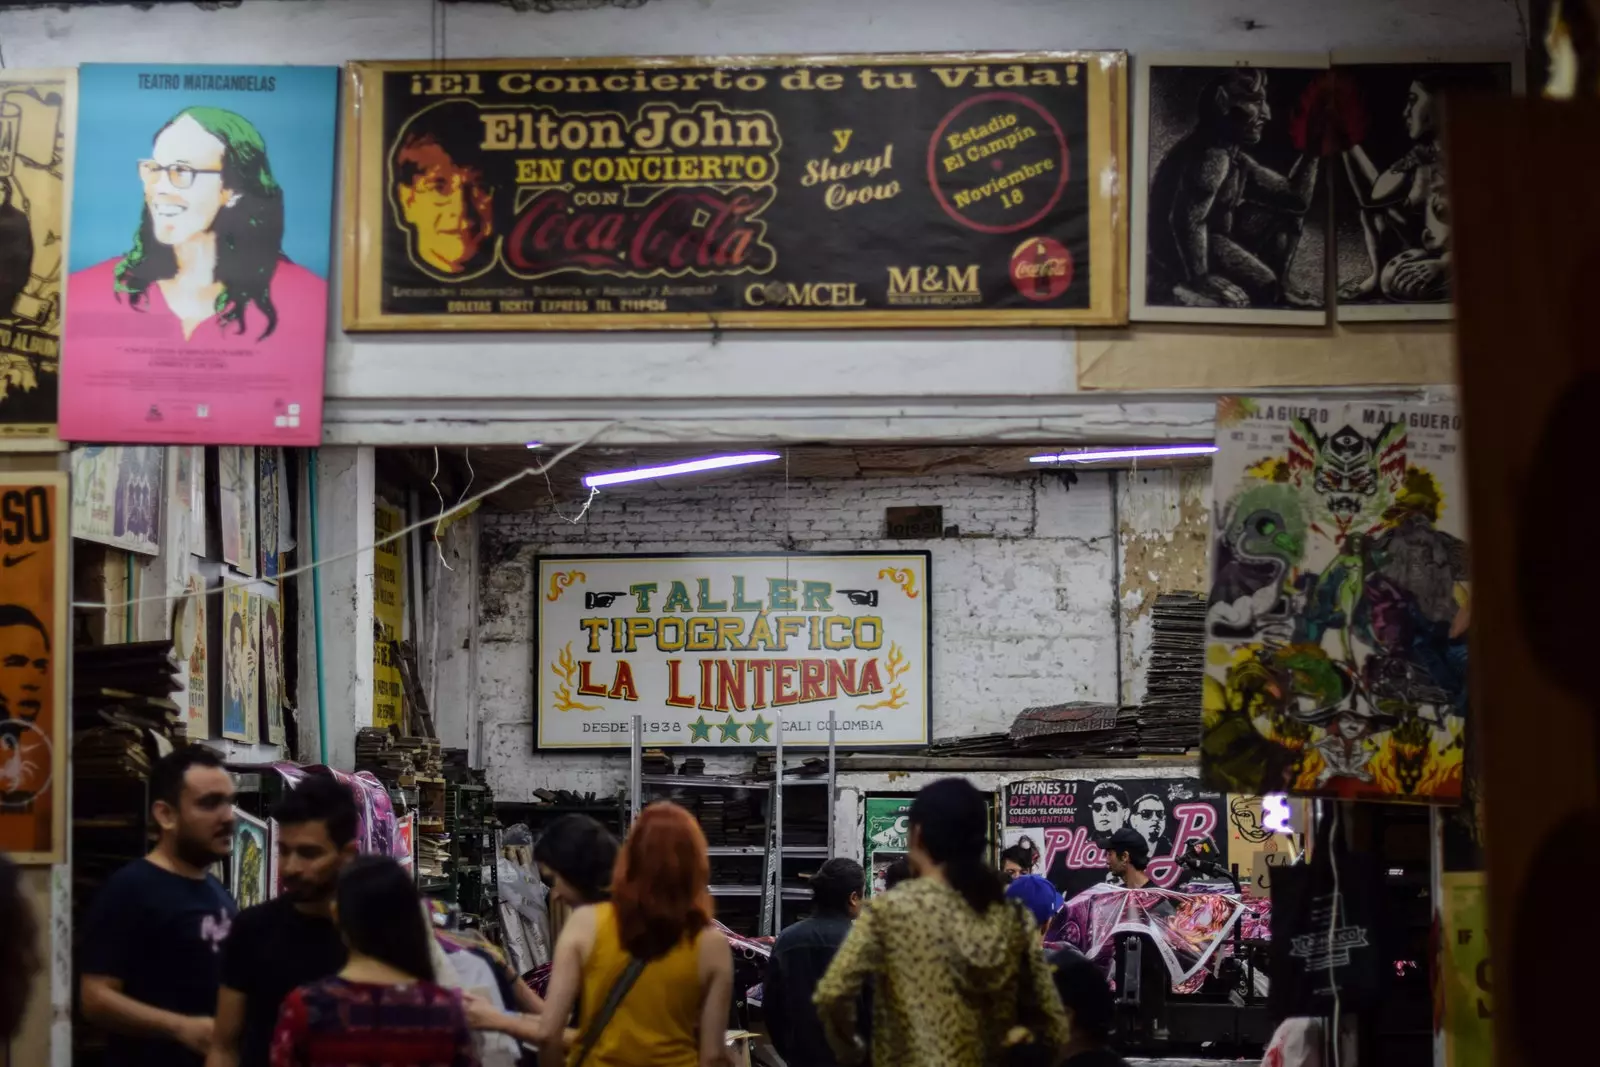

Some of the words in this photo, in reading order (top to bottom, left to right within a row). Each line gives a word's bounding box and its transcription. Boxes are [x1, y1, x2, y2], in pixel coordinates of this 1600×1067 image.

[138, 73, 179, 90] TEATRO
[497, 70, 767, 94] Concierto
[780, 69, 844, 91] de
[858, 70, 917, 90] tu
[931, 65, 1079, 88] Vida!
[480, 113, 625, 150] Elton
[633, 110, 771, 151] John
[833, 128, 853, 153] y
[947, 113, 1018, 150] Estadio
[943, 152, 966, 173] El
[966, 124, 1038, 166] Campín
[515, 158, 564, 183] EN
[572, 155, 768, 182] CONCIERTO
[801, 143, 894, 188] Sheryl
[825, 181, 900, 211] Crow
[953, 157, 1055, 208] Noviembre
[573, 191, 619, 206] CON
[1000, 189, 1025, 211] 18
[886, 264, 981, 293] M&M
[744, 282, 867, 306] CMCEL
[1248, 405, 1329, 424] LAGUERO
[0, 485, 50, 546] SO
[630, 575, 834, 613] TALLER
[580, 608, 885, 653] TIPOGRÁFICO
[577, 659, 640, 701] LA
[666, 657, 884, 714] LINTERNA
[582, 722, 629, 733] DESDE
[642, 721, 682, 732] 1938
[781, 720, 812, 732] CALI
[1009, 781, 1061, 795] VIERNES
[1064, 782, 1078, 794] 11
[1009, 795, 1026, 807] DE
[1029, 794, 1075, 806] MARZO
[1009, 807, 1037, 815] COLISEO
[1009, 815, 1075, 824] BUENAVENTURA
[1043, 826, 1108, 879] Pla
